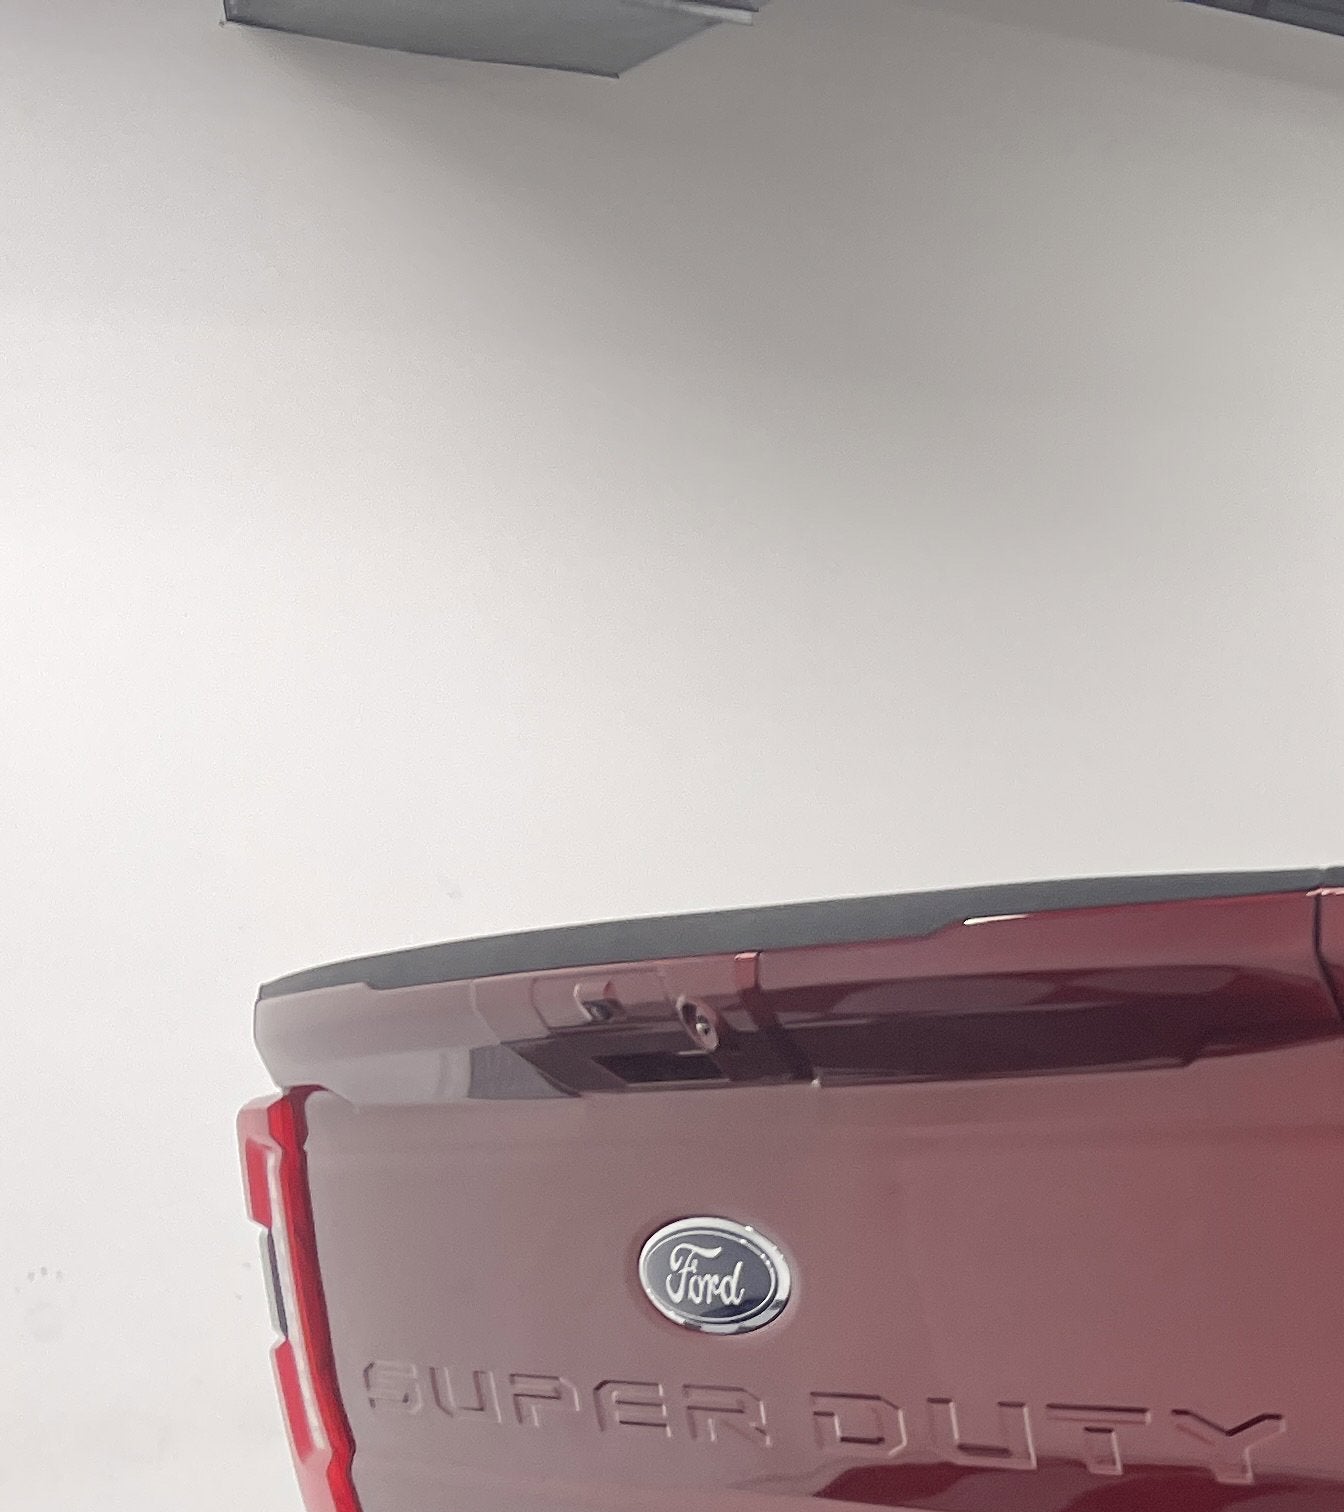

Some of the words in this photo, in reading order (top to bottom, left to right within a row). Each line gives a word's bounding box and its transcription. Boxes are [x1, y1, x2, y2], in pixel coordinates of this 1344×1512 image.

[665, 1242, 745, 1305] Ford
[362, 1359, 772, 1448] SUPER
[808, 1390, 1286, 1485] DUTY
